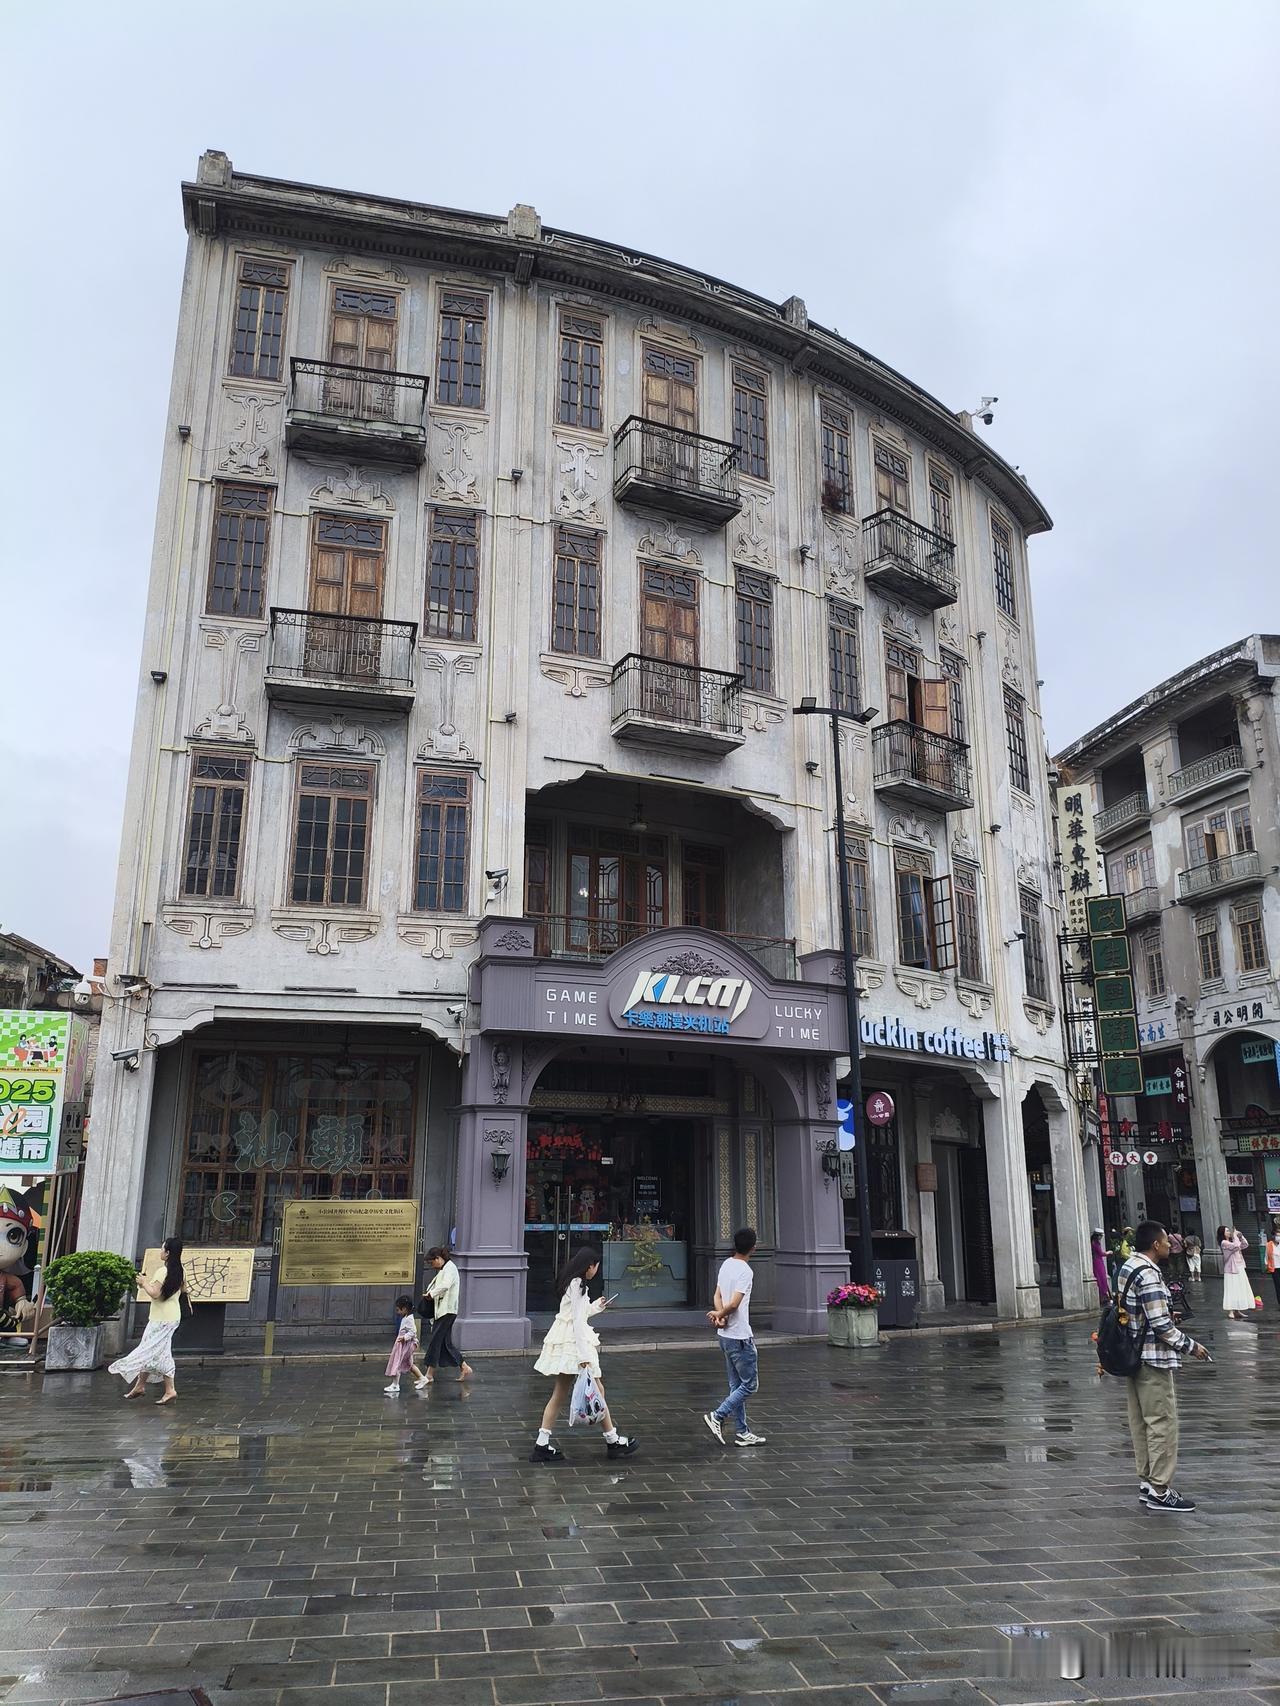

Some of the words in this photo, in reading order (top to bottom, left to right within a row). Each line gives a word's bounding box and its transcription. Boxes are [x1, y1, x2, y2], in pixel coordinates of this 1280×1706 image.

[546, 988, 598, 1004] GAME
[547, 1010, 598, 1027] TIME
[775, 1005, 822, 1021] LUCKY
[776, 1026, 820, 1041] TIME
[861, 1016, 919, 1050] uckin
[924, 1026, 986, 1060] coffee
